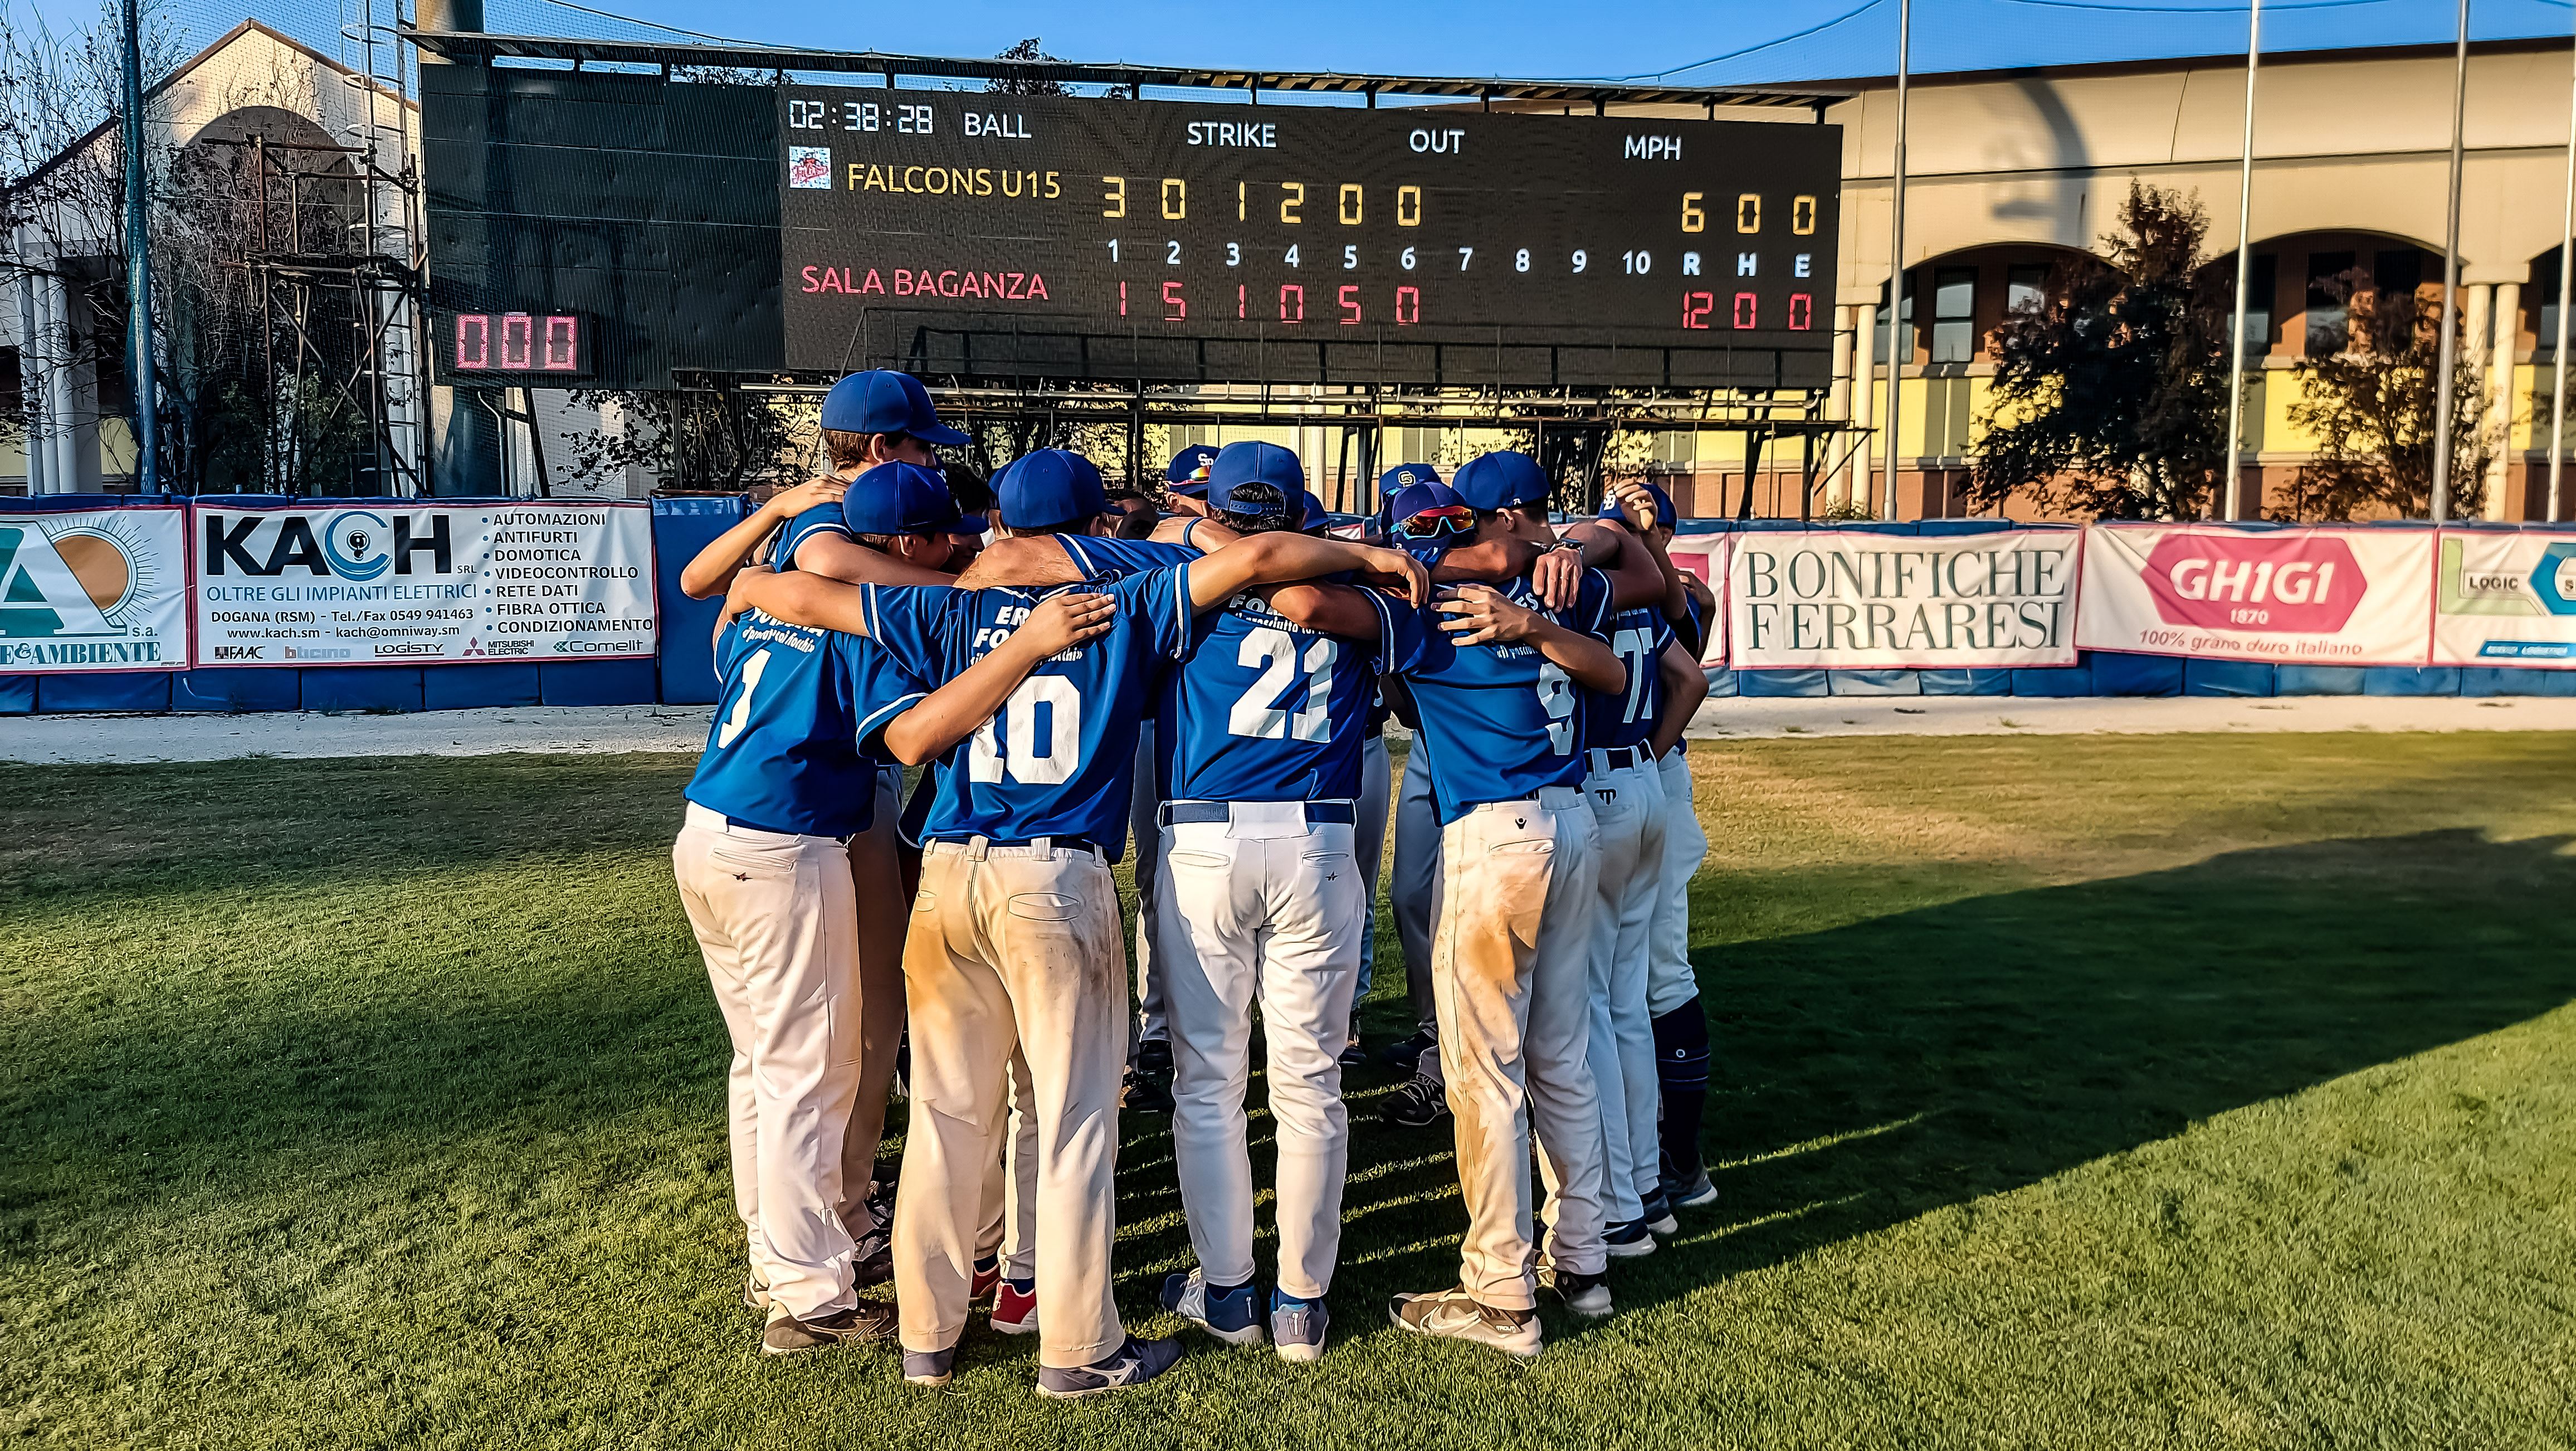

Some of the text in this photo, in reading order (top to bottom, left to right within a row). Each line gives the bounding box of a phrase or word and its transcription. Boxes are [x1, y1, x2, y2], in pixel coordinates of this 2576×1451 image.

[789, 100, 1681, 161] 02:38:28 BALL STRIKE OUT MPH
[848, 163, 1817, 236] FALCONS U15 3 0 1 2 0 0 6 0 0
[1108, 238, 1812, 278] 1 2 3 4 5 6 7 8 9 10 R H E
[802, 265, 1812, 331] SALA BAGANZA 1 5 1 0 5 0 12 0 0
[493, 513, 606, 525] AUTOMAZIONI
[493, 530, 578, 543] ANTIFURTI
[206, 510, 477, 582] KACH SRL
[494, 549, 582, 562] DOMOTICA
[495, 566, 638, 580] VIDEOCONTROLLO
[1745, 550, 2065, 600] BONIFICHE
[207, 583, 477, 602] OLTRE GLI IMPIANTI ELETTRICI
[496, 584, 578, 598] RETE DATI
[212, 611, 270, 623] DOGANA
[275, 611, 315, 625] (RSM)
[331, 611, 386, 622] Tel./Fax
[390, 609, 422, 621] 0549
[426, 608, 474, 620] 941463
[497, 602, 606, 616] FIBRA OTTICA
[2230, 608, 2270, 625] 1870
[132, 626, 158, 637] s.a.
[227, 627, 320, 638] www.kach.sm
[336, 625, 460, 639] kach@omniway.sm
[497, 619, 653, 634] CONDIZIONAMENTO
[1746, 601, 2063, 651] FERRARESI
[374, 640, 444, 653] LOGISTY
[488, 640, 534, 649] MITSUBISHI
[2139, 629, 2363, 656] 100% grano duro italiano
[230, 646, 264, 660] FAAC
[1228, 626, 1338, 743] 21
[718, 649, 772, 749] 1
[969, 675, 1080, 784] 10
